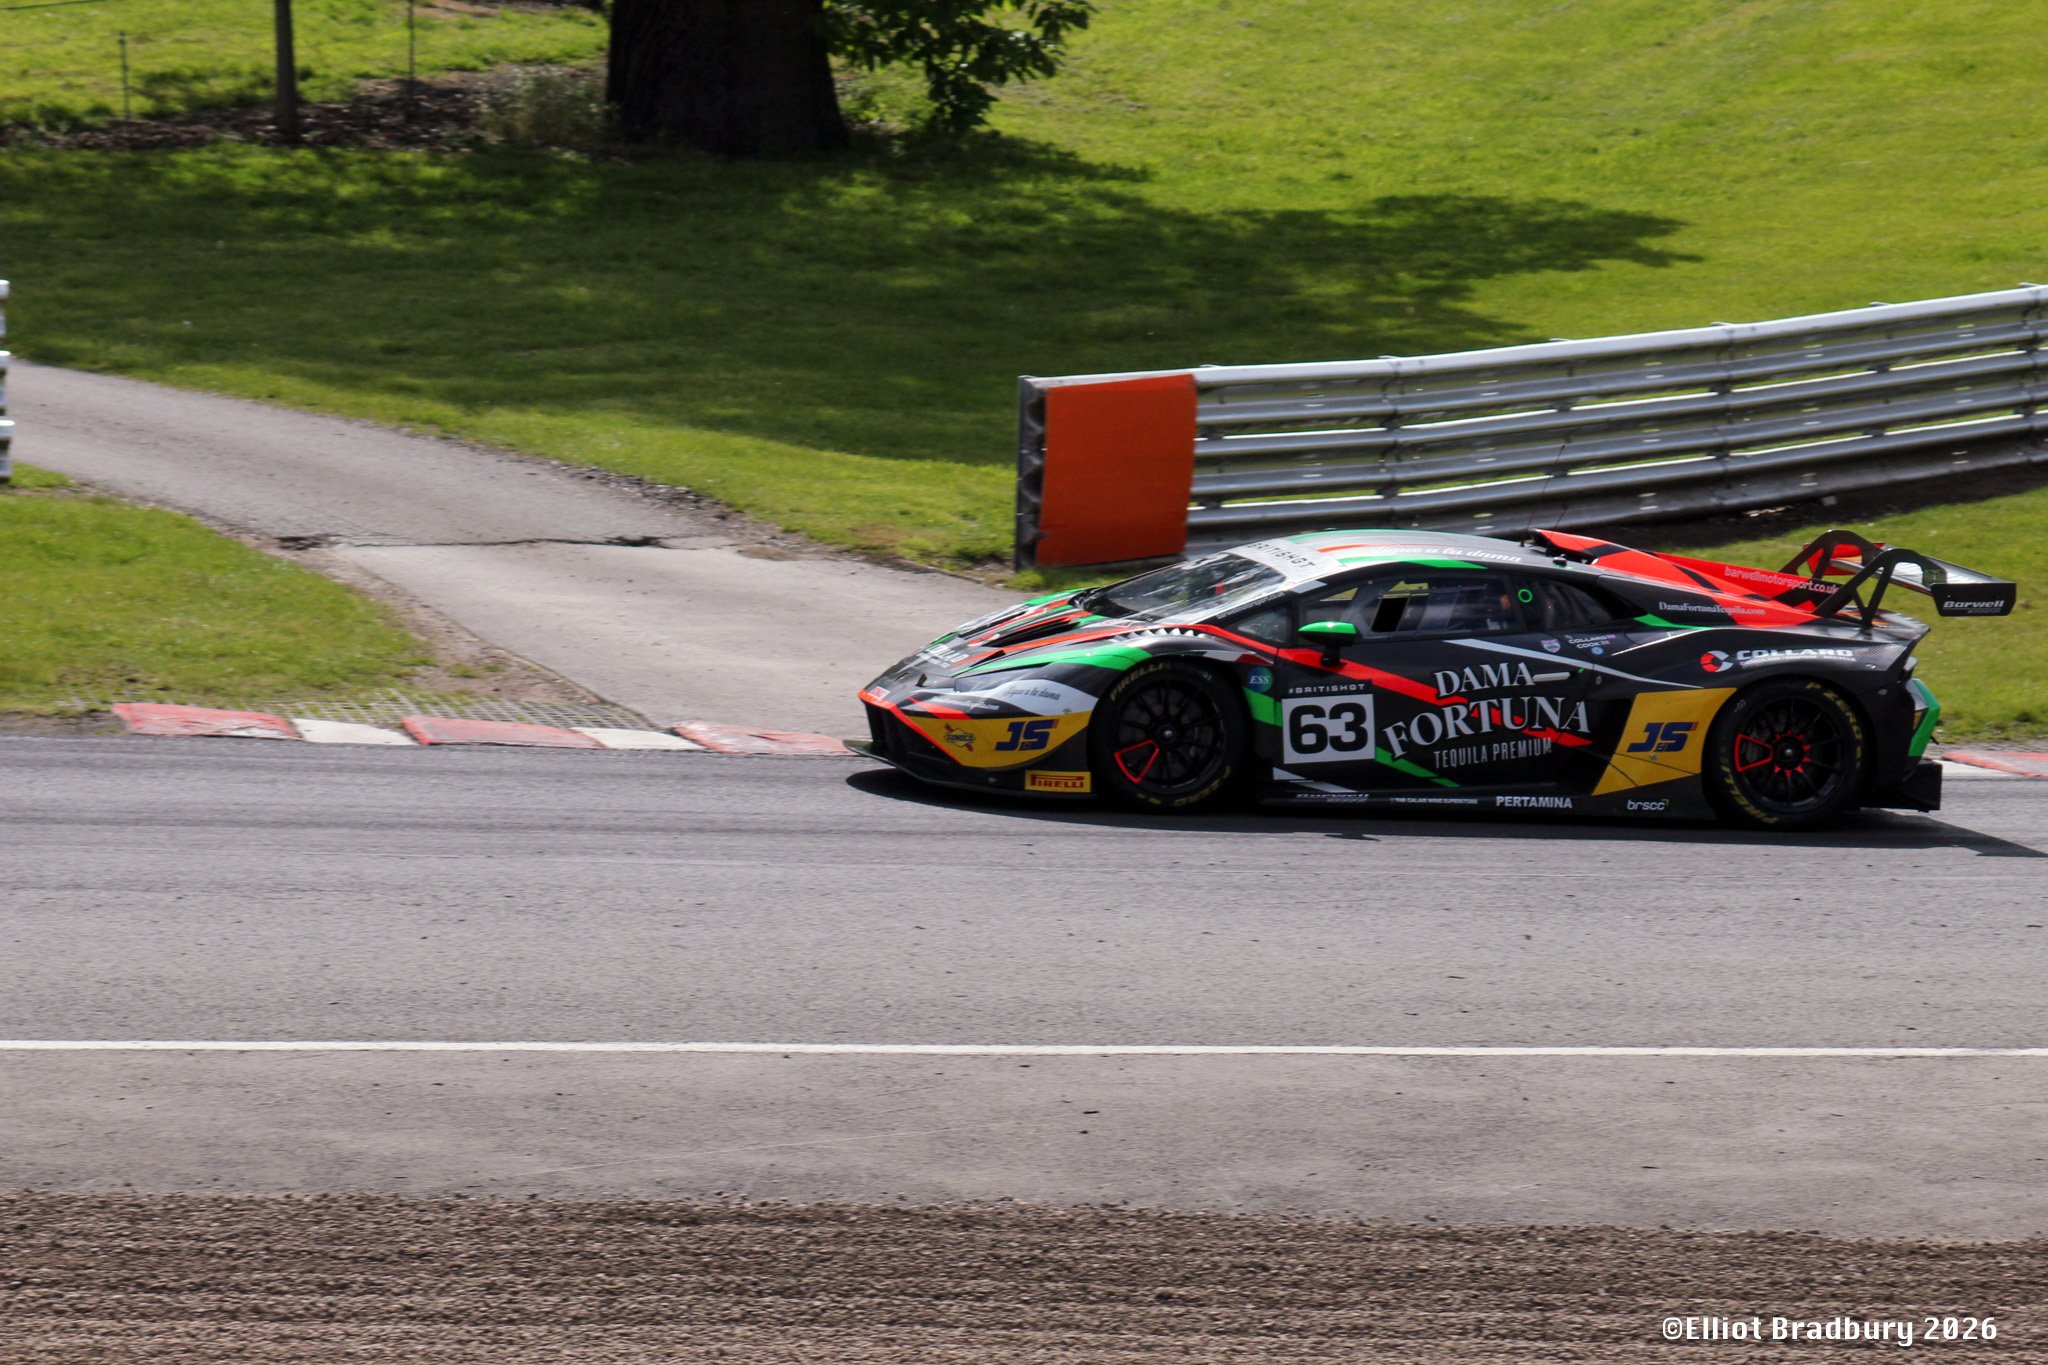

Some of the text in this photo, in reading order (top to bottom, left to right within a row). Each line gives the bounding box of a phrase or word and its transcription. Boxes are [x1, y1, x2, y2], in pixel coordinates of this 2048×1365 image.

[1443, 546, 1463, 555] la
[1466, 549, 1523, 563] dama
[1725, 566, 1839, 594] barwellmotorsport.co.uk
[1659, 601, 1765, 615] DamaFortunaTequila.com
[1943, 600, 2004, 608] Barwell
[1568, 635, 1607, 644] COLLARD
[1736, 649, 1853, 661] COLLARD
[1110, 662, 1164, 701] PIRELLI
[1250, 675, 1270, 684] ESS
[1434, 662, 1536, 697] DAMA
[1288, 684, 1365, 694] #BRITISHGT
[1289, 702, 1368, 754] 63
[1383, 696, 1591, 758] FORTUNA
[995, 719, 1059, 751] JS
[1626, 722, 1699, 752] JS
[1434, 737, 1552, 769] TEQUILA PREMIUM
[1030, 774, 1084, 788] PIRELLI
[1496, 796, 1573, 808] PERTAMINA
[1627, 800, 1666, 810] brscc
